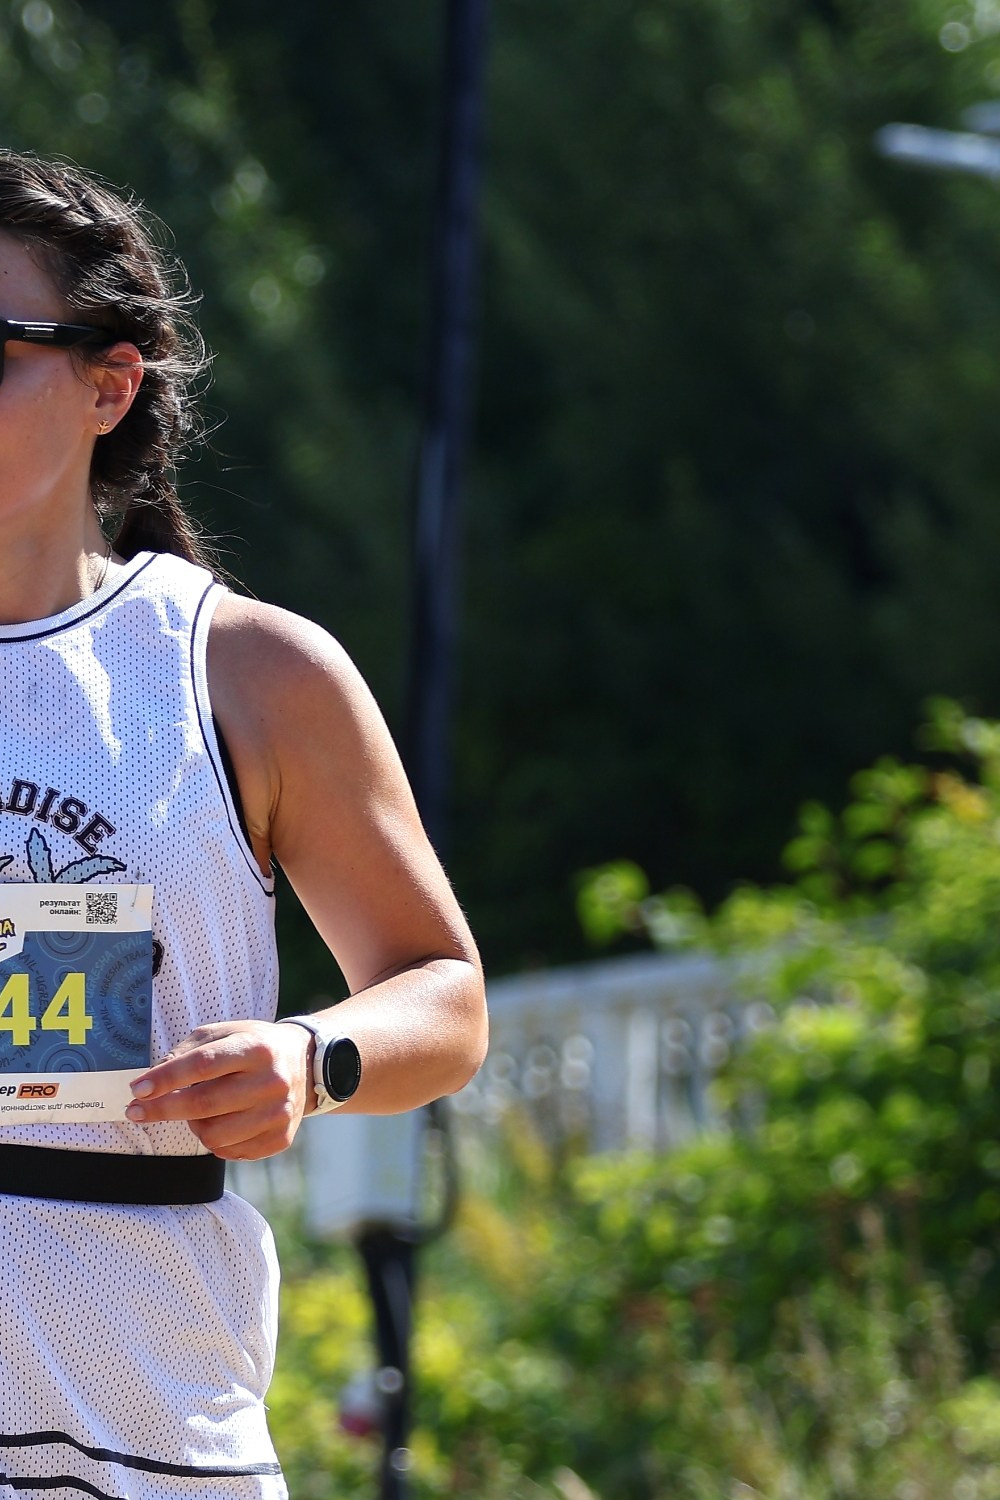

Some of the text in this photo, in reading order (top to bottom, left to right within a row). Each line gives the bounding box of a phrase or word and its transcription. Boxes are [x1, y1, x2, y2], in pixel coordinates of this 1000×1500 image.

[39, 900, 81, 908] результат
[49, 907, 81, 916] онлайн:
[19, 1085, 56, 1096] PRO
[0, 1104, 45, 1112] экстренной
[48, 1103, 62, 1111] для
[64, 1101, 105, 1111] Телефоны
